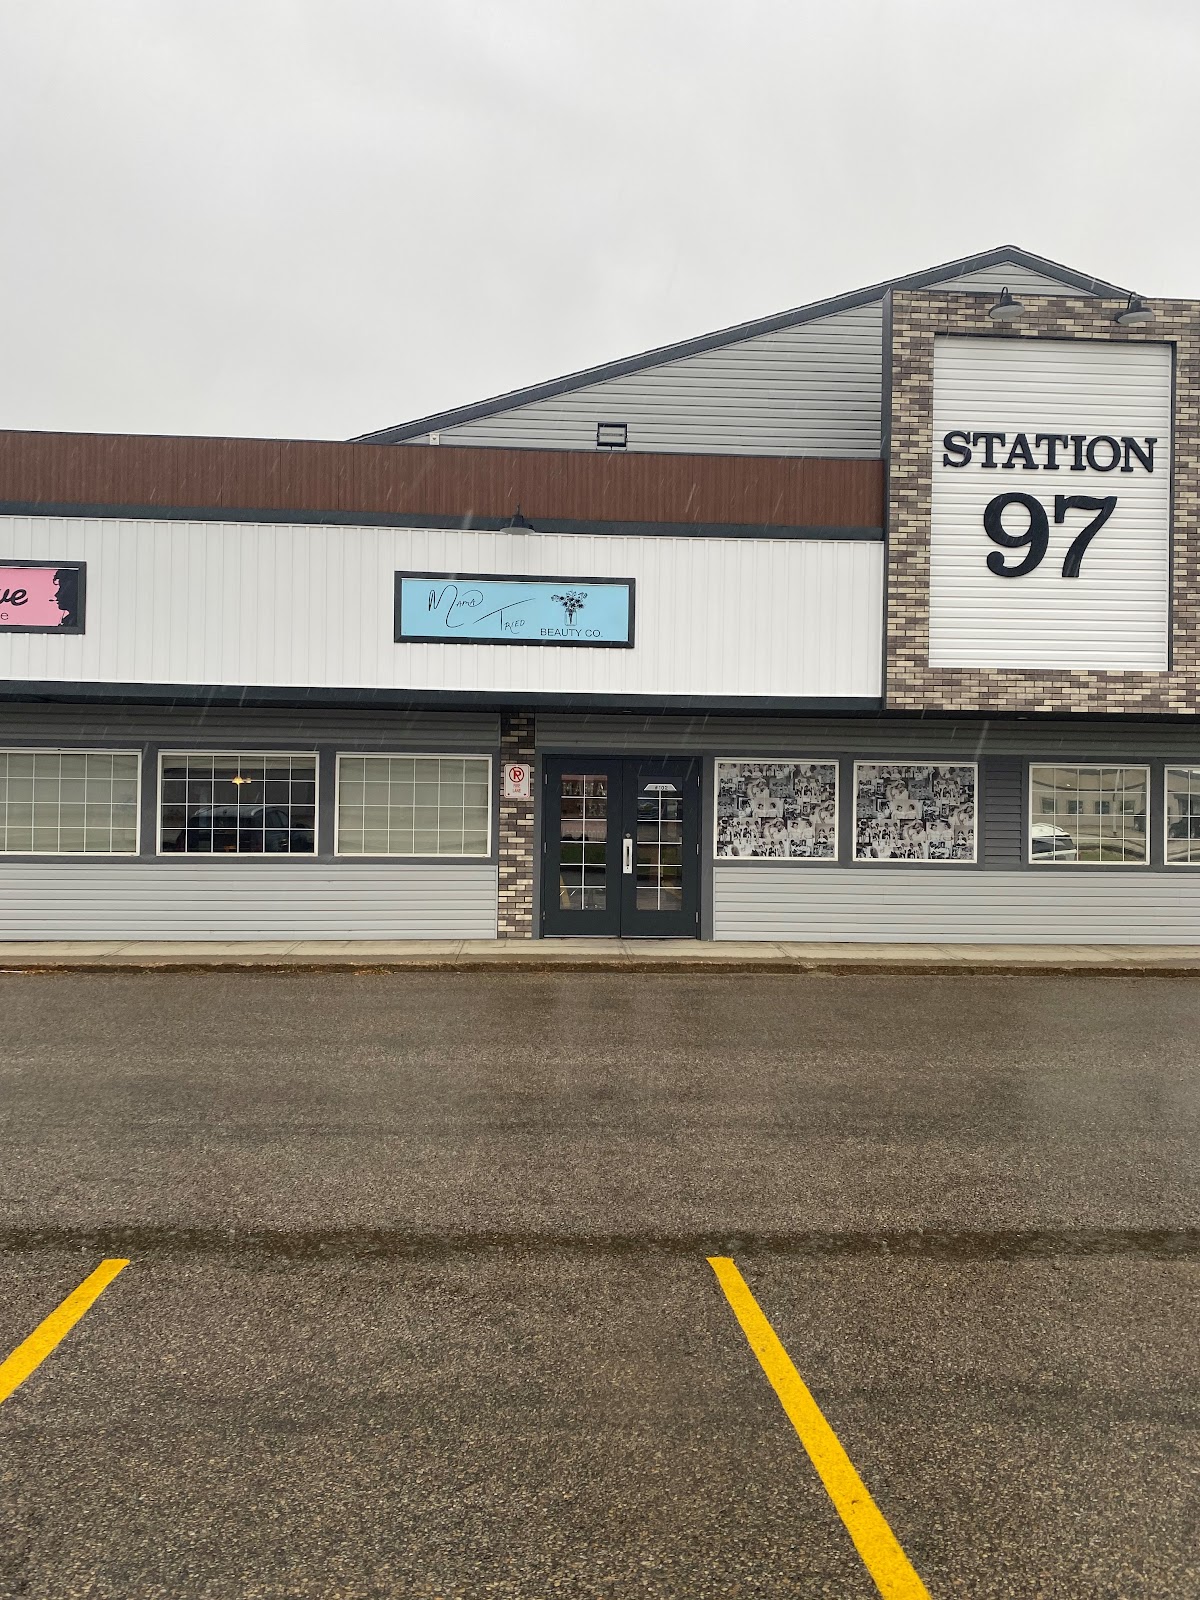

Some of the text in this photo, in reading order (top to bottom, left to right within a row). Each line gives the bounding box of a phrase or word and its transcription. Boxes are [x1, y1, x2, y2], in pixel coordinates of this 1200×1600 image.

[943, 430, 1158, 473] STATION
[983, 491, 1118, 578] 97
[540, 628, 603, 638] BEAUTY CO.
